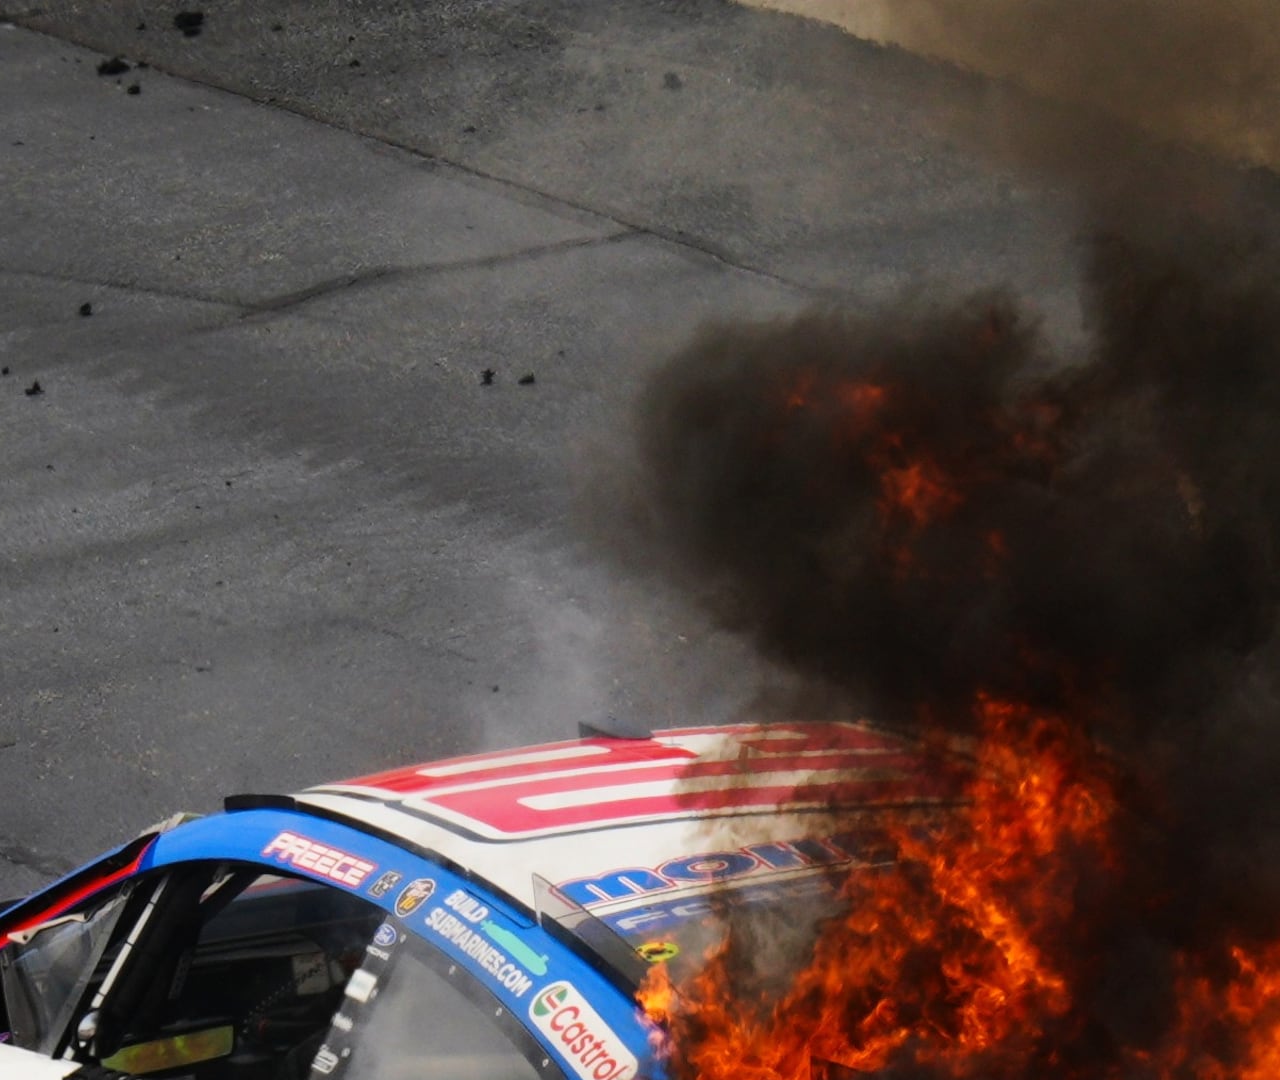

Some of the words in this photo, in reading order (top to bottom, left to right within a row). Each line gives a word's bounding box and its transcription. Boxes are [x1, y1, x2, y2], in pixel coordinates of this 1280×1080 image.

[263, 831, 377, 887] PREECE
[444, 890, 489, 924] BUILD
[425, 907, 533, 998] SUBMARINES.COM
